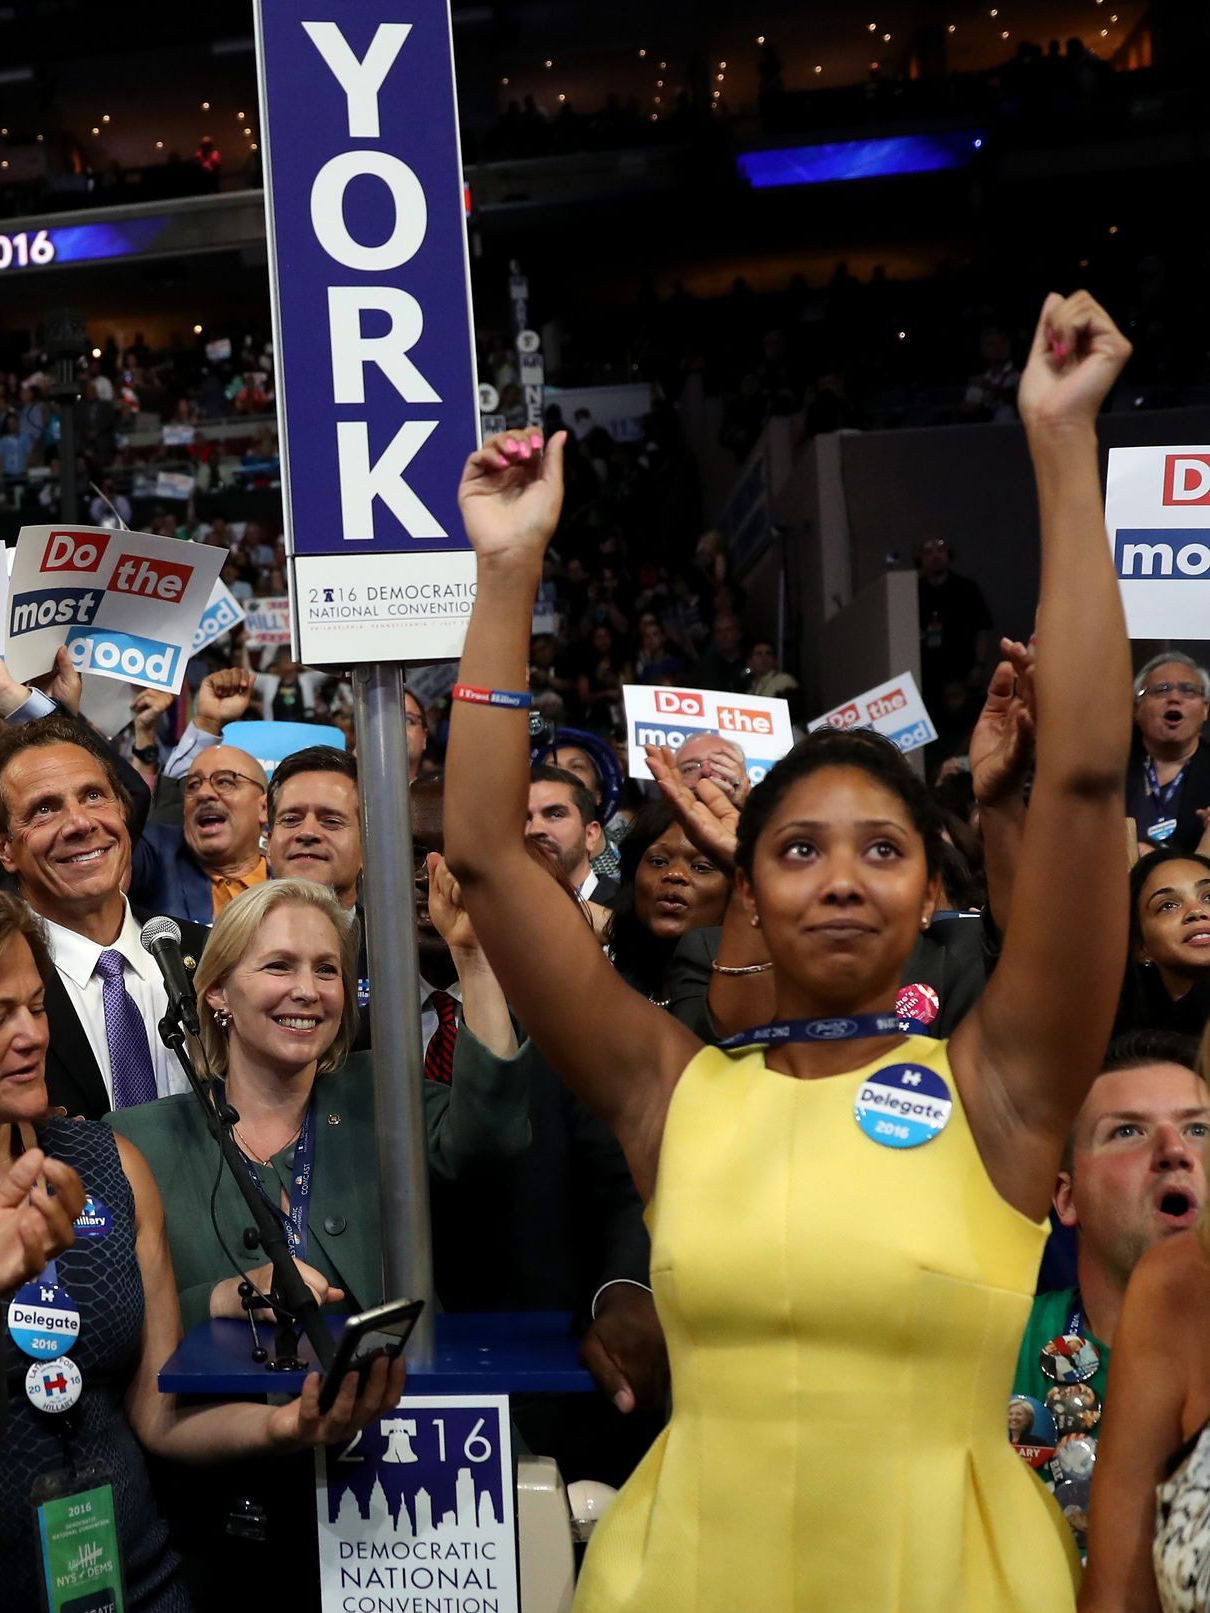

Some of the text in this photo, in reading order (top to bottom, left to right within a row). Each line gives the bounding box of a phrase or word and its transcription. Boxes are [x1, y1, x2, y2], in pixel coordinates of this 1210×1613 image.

[301, 21, 448, 540] YORK
[47, 537, 183, 598] Do the
[1122, 543, 1210, 575] mo
[367, 582, 478, 601] DEMOCRATIC
[13, 592, 96, 632] most
[192, 600, 232, 643] ood
[309, 605, 379, 618] NATIONAL
[67, 636, 177, 684] good
[658, 692, 770, 733] Do the
[829, 694, 904, 728] Do the
[860, 1088, 943, 1120] Delegate
[875, 1121, 909, 1139] 2016
[301, 1163, 311, 1195] COMCAST
[13, 1310, 78, 1331] Delegate
[30, 1338, 58, 1351] 2016
[28, 1384, 41, 1394] 20
[71, 1375, 81, 1385] 16
[42, 1397, 74, 1411] HILLARY
[68, 1502, 92, 1517] 2016
[339, 1541, 496, 1560] DEMOCRATIC
[57, 1561, 113, 1588] NYS DEMS
[340, 1567, 498, 1589] NATIONAL
[342, 1597, 498, 1613] CONVENTION
